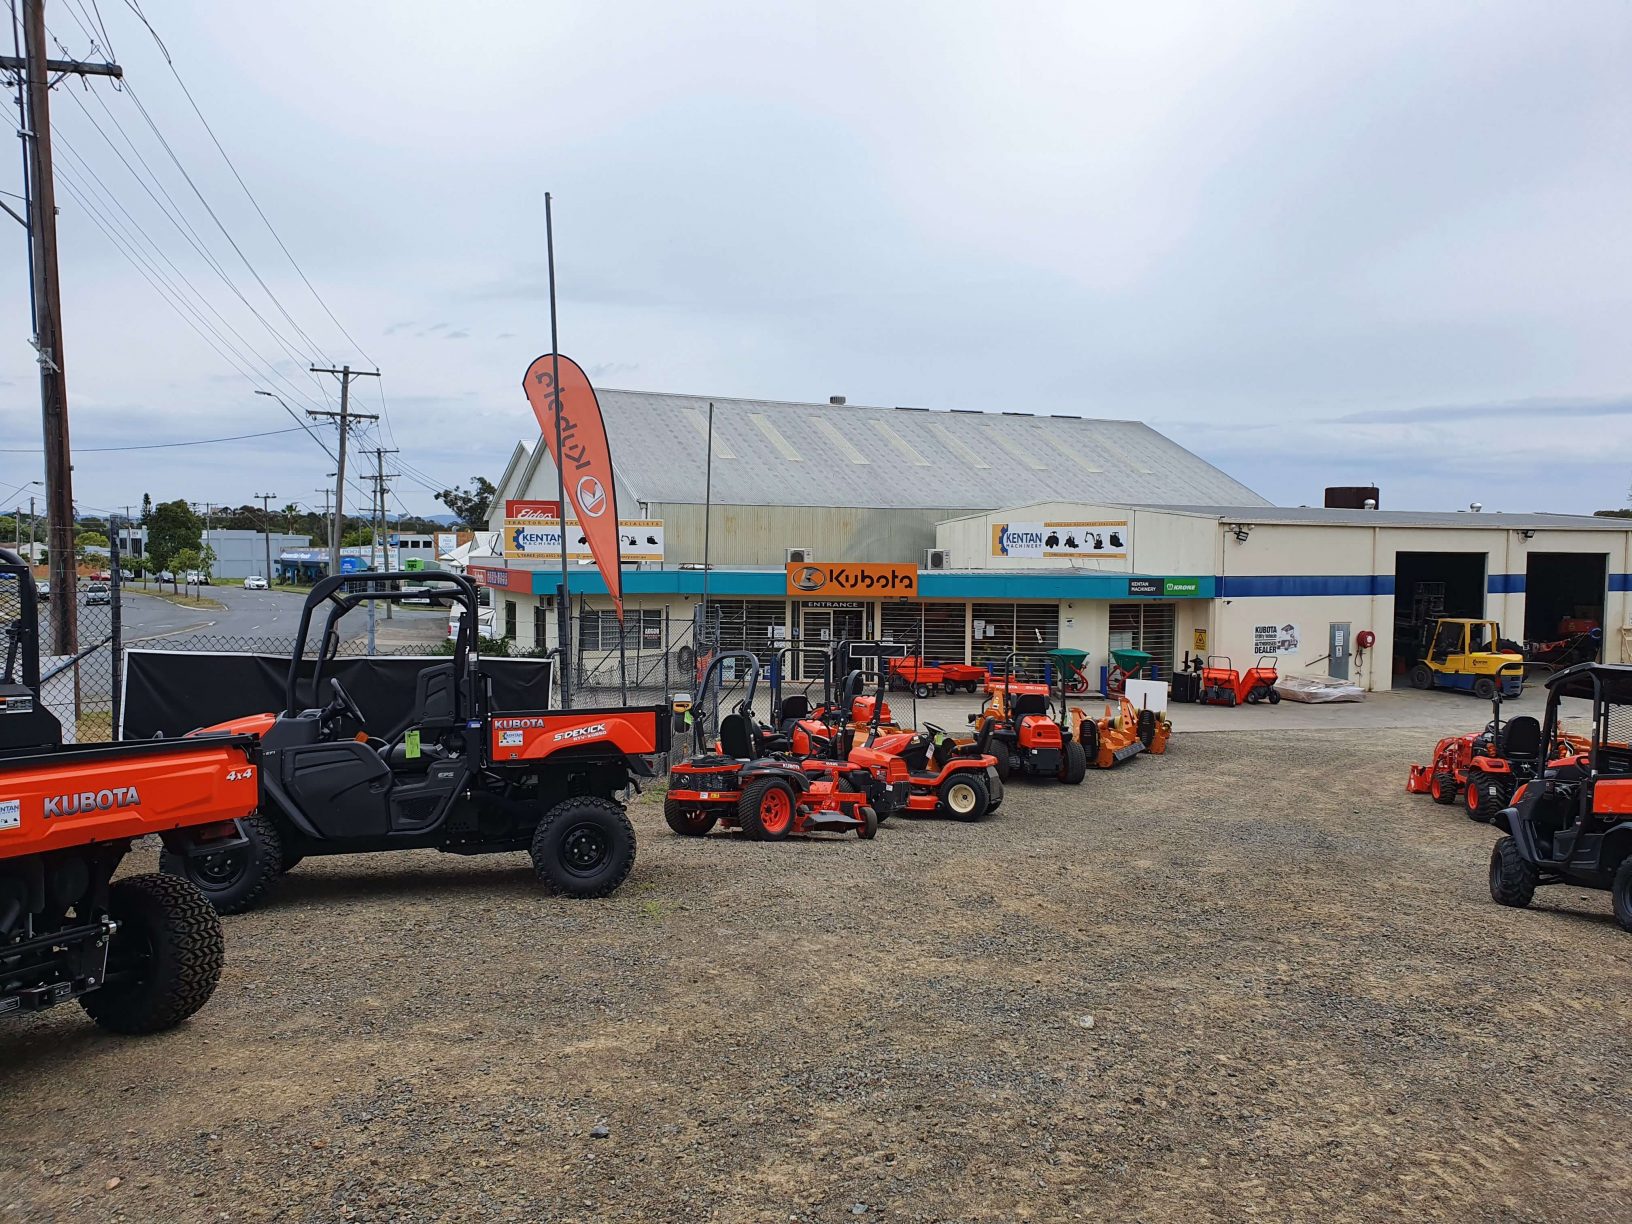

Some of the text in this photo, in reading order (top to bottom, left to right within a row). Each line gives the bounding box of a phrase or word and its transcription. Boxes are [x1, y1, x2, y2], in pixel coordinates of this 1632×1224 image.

[517, 508, 553, 518] Elders
[1006, 532, 1042, 544] KENTAN
[829, 568, 913, 589] Kubota
[494, 718, 545, 730] KUBOTA
[226, 768, 253, 782] 4x4
[43, 786, 141, 819] KUBOTA
